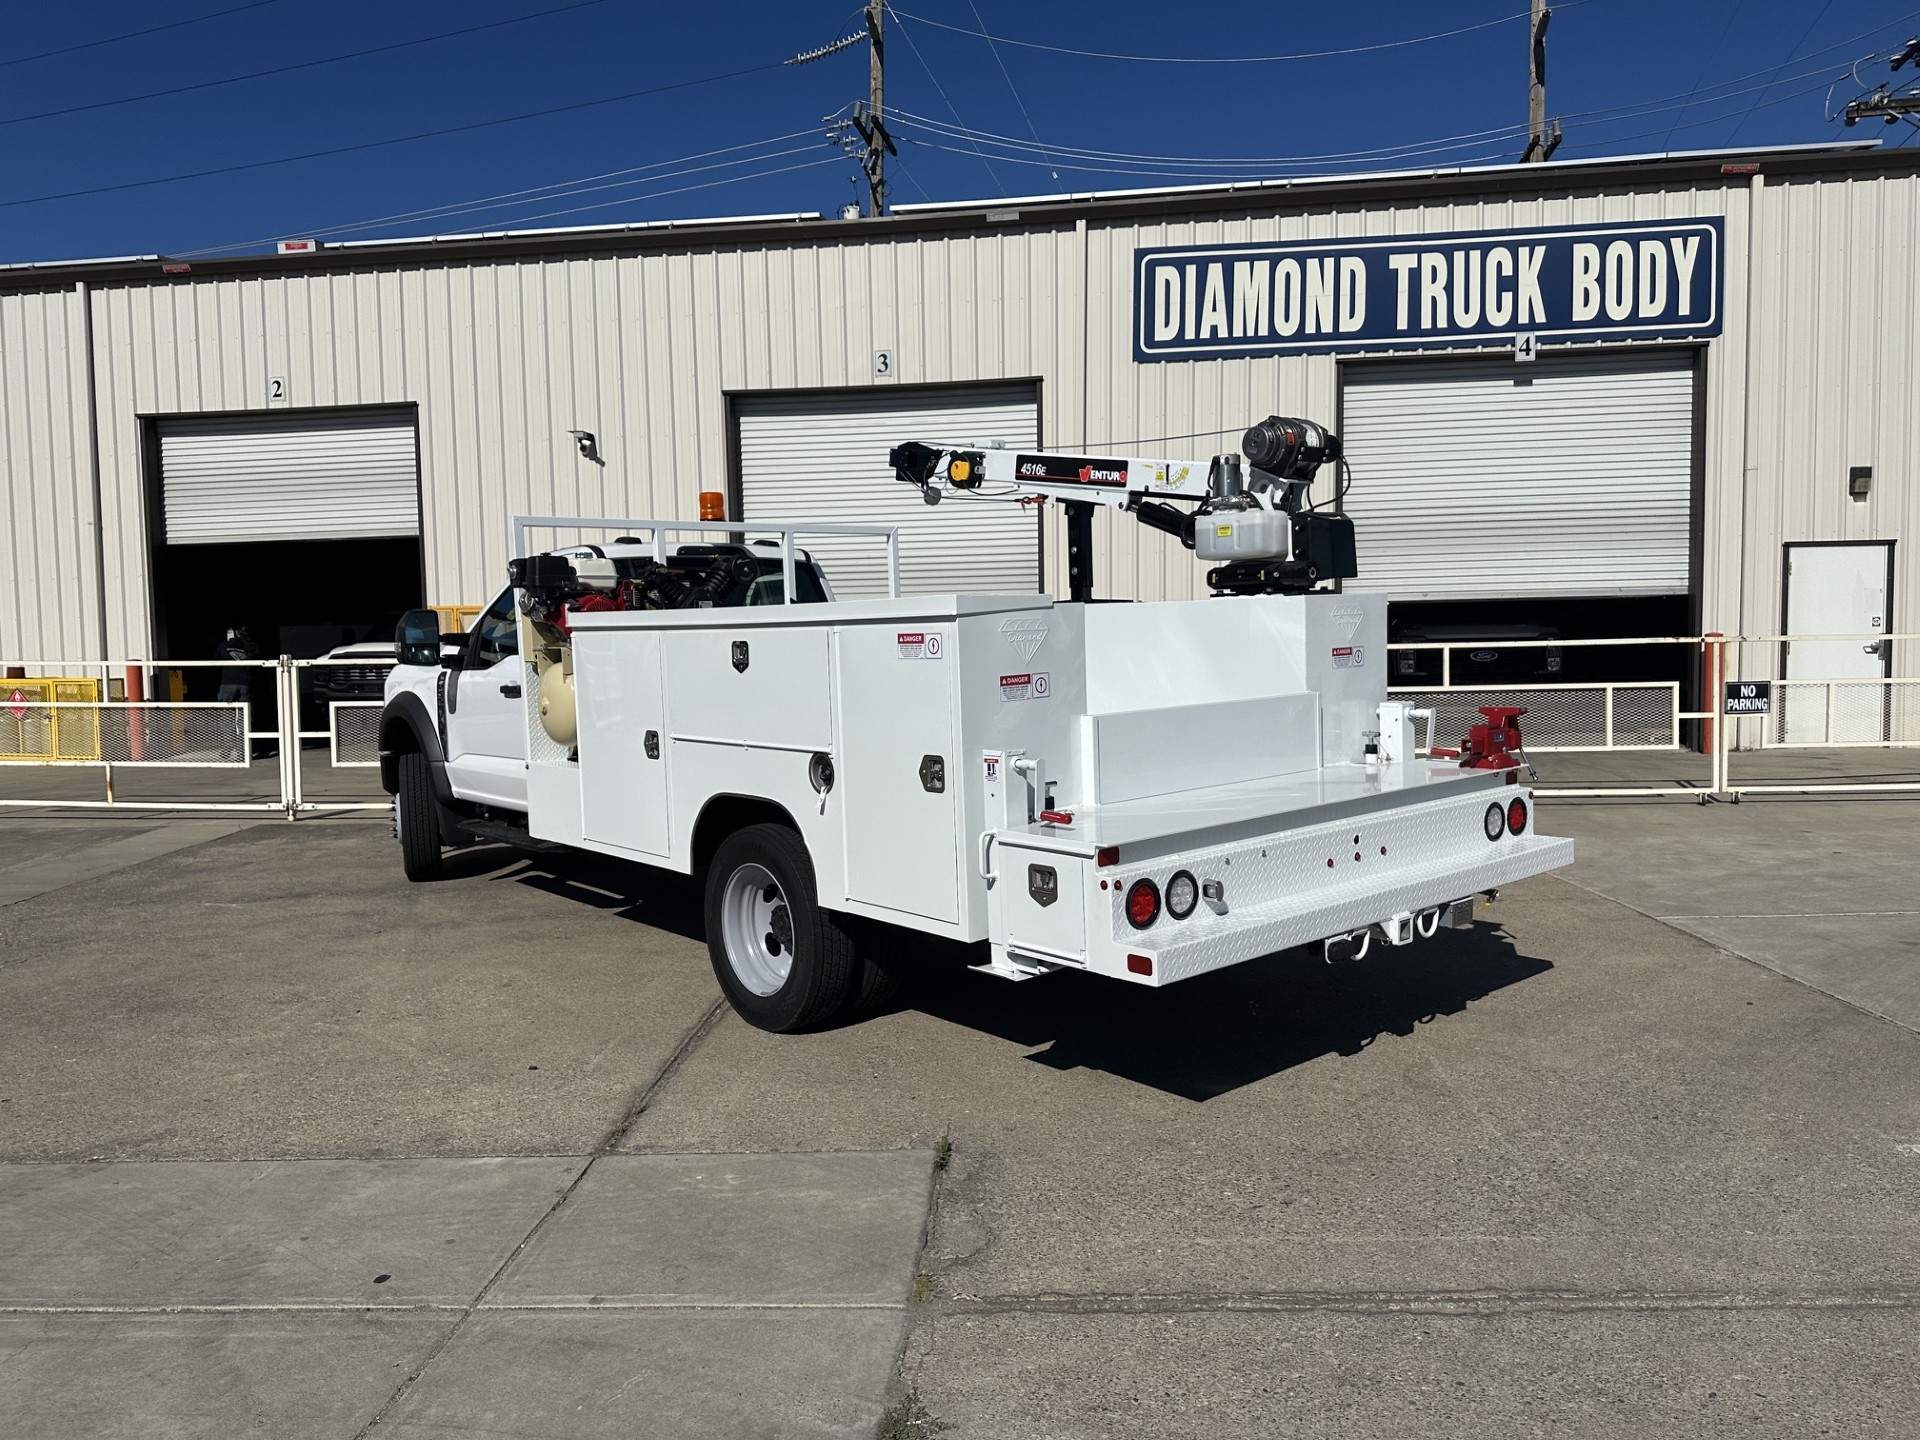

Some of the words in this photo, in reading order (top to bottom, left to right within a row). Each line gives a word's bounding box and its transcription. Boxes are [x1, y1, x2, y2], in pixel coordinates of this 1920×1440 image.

[1154, 256, 1367, 342] DIAMOND
[1389, 245, 1547, 331] TRUCK
[1571, 236, 1700, 322] BODY
[1519, 336, 1532, 356] 4
[877, 353, 889, 373] 3
[271, 380, 283, 398] 2
[1020, 463, 1047, 476] 4516E
[1079, 465, 1128, 482] VENTURO
[1007, 676, 1029, 684] DANGER
[1740, 684, 1757, 698] NO
[1727, 698, 1768, 711] PARKING
